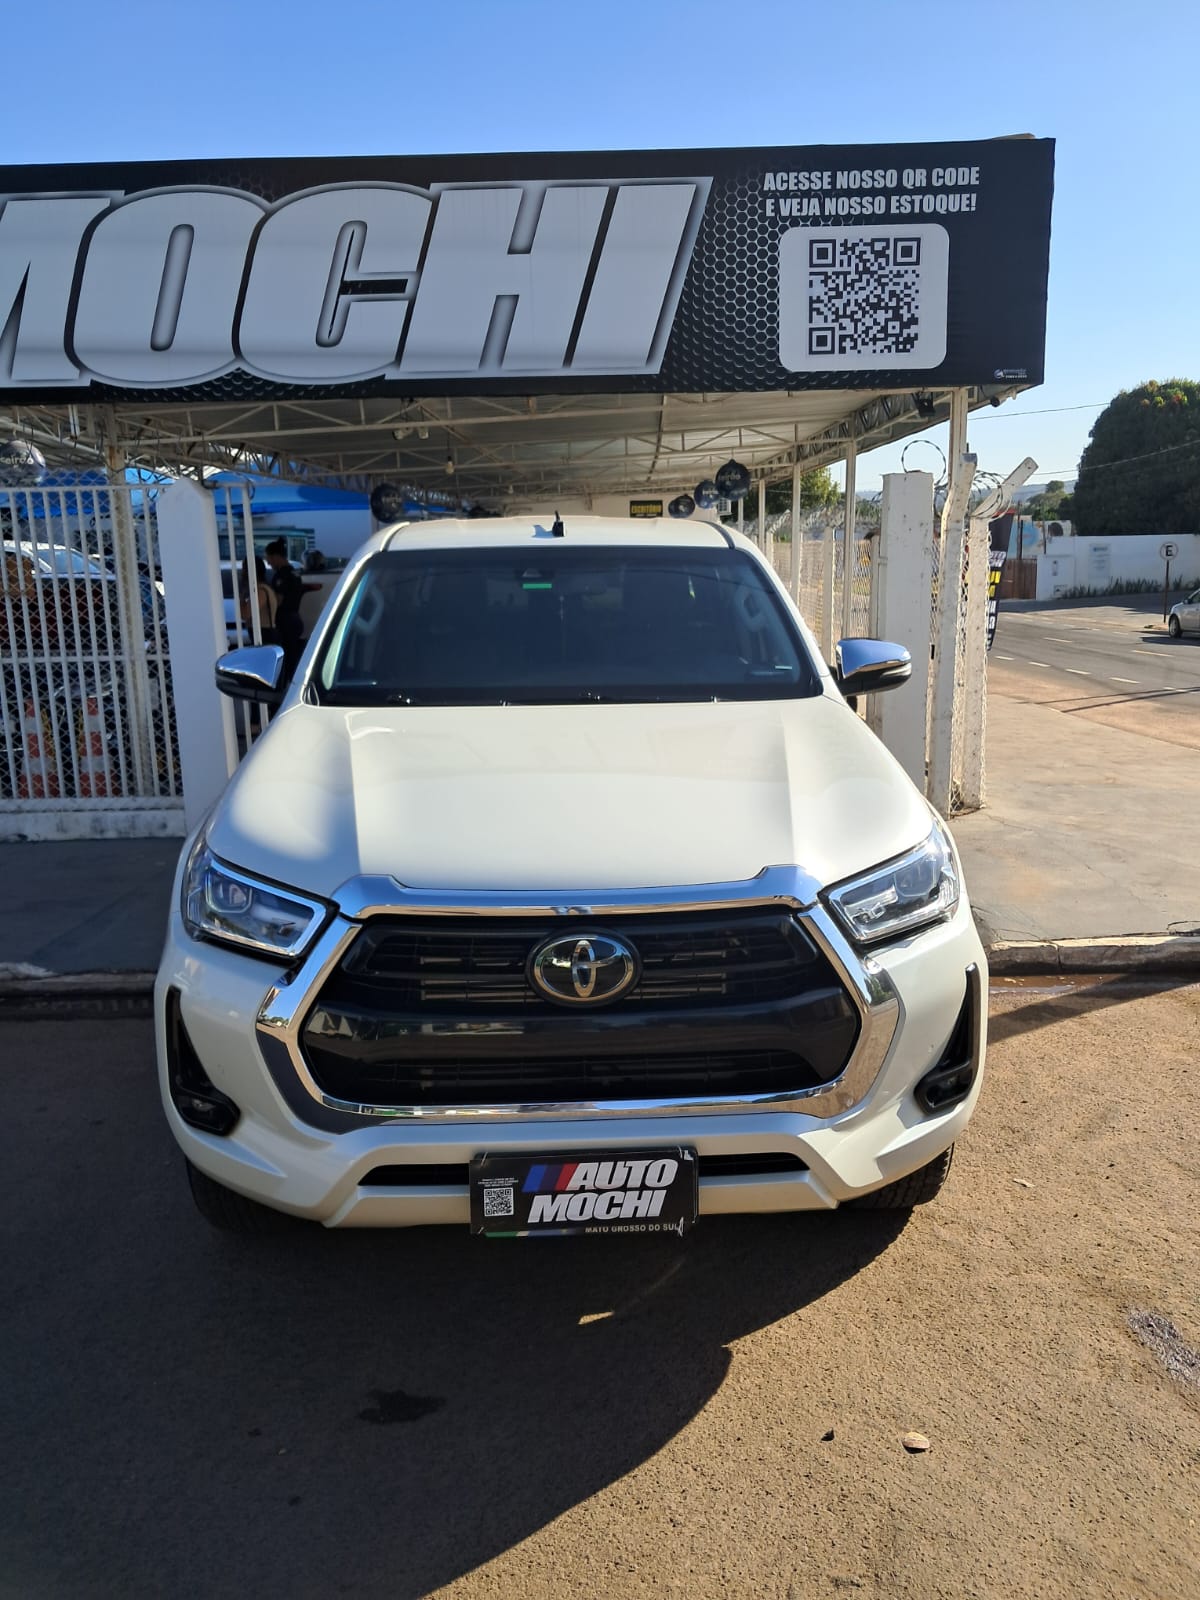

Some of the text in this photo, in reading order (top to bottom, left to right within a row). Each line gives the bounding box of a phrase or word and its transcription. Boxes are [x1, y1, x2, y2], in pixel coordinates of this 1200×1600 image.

[763, 166, 980, 191] ACESSE NOSSO QR CODE
[765, 193, 977, 217] E VEJA NOSSO ESTOQUE!
[1165, 545, 1173, 557] E
[565, 1159, 679, 1191] AUTO
[527, 1189, 667, 1224] MOCHI
[611, 1224, 647, 1232] GROSSO
[648, 1223, 661, 1231] DO
